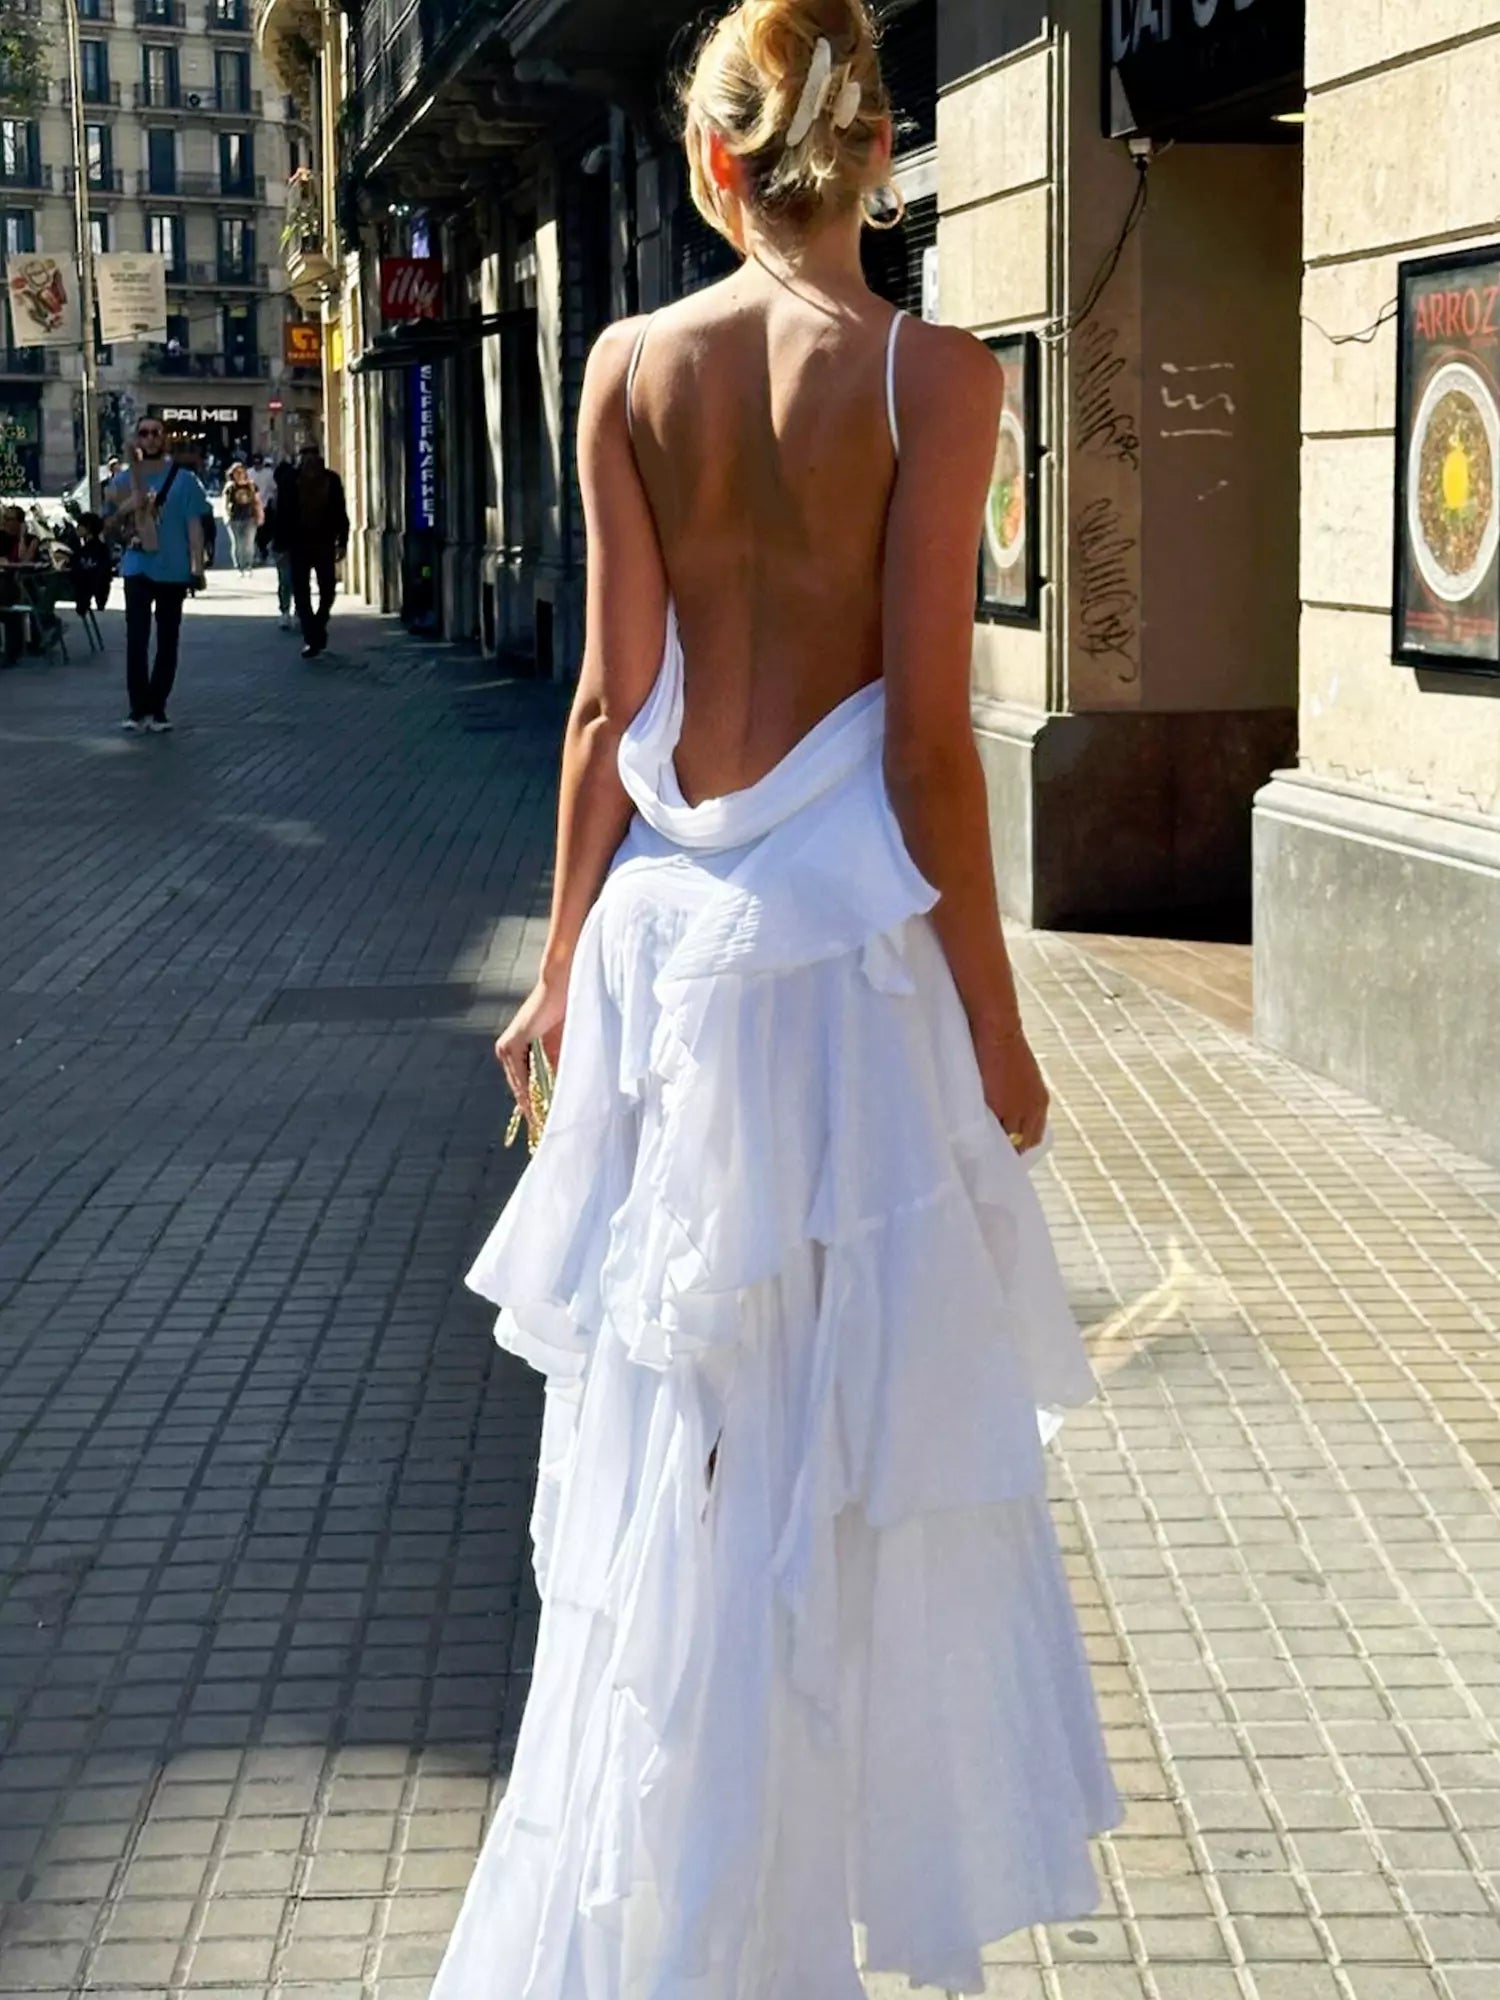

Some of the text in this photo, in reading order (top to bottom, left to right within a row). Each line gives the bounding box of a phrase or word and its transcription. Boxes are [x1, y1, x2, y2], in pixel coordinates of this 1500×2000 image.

[387, 266, 440, 319] illy
[1416, 287, 1500, 341] ARROZ
[162, 408, 238, 422] PAI MEI
